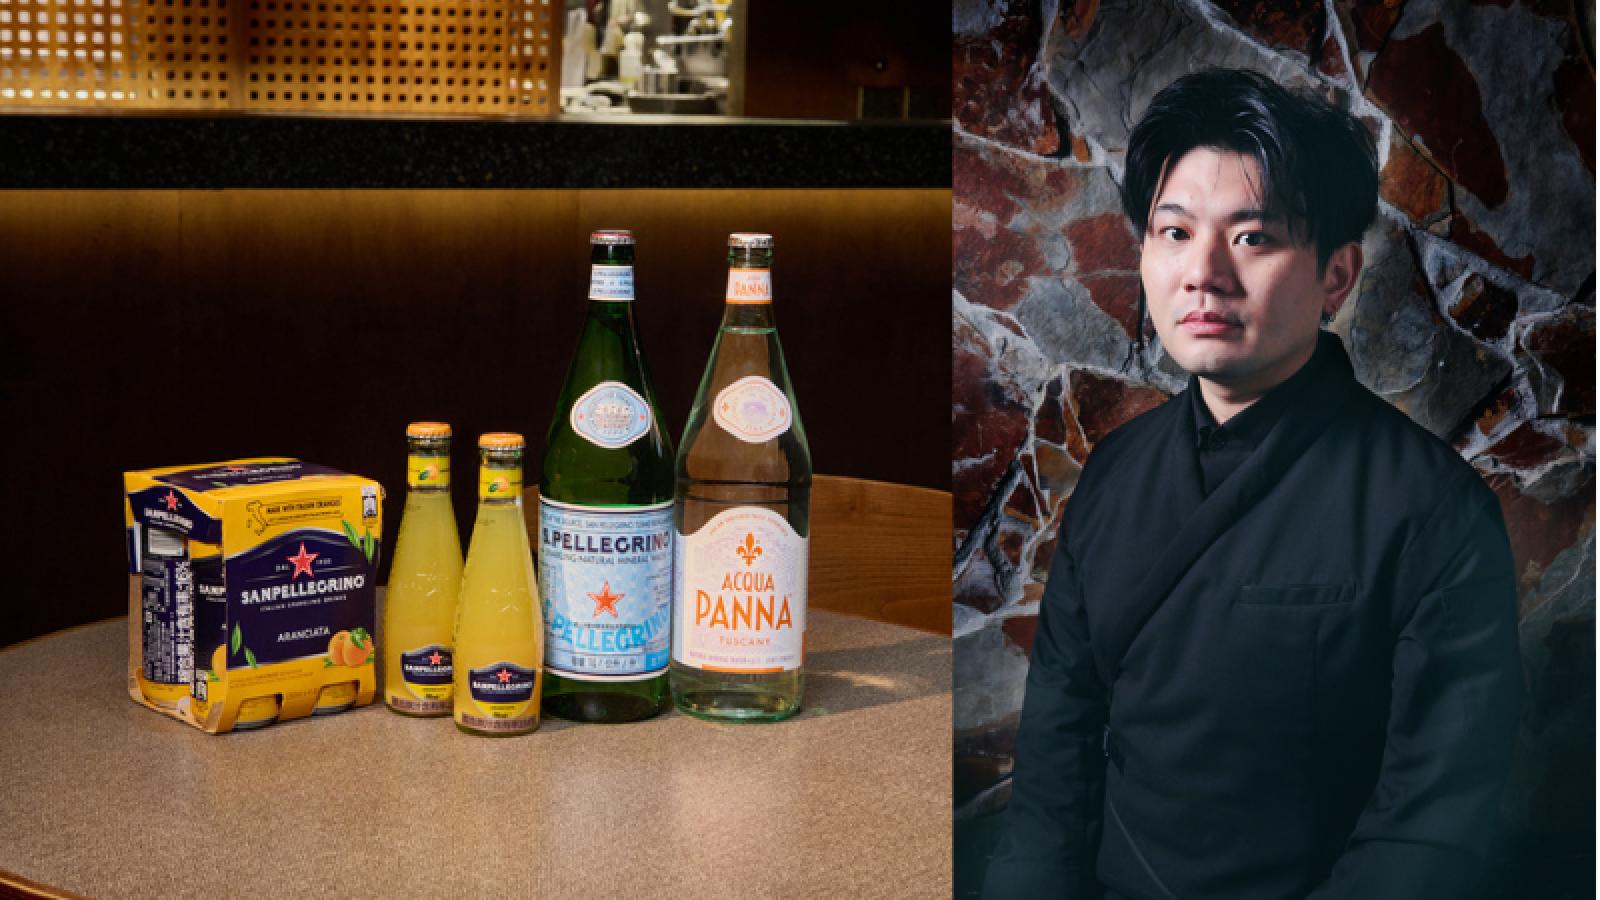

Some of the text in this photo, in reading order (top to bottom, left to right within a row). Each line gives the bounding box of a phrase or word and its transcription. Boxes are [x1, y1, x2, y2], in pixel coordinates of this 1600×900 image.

[241, 575, 365, 605] SANPELLEGRINO
[721, 571, 775, 592] ACQUA
[695, 589, 793, 630] PANNA
[277, 625, 331, 643] ARANCIATA
[719, 635, 771, 647] TUSCANY
